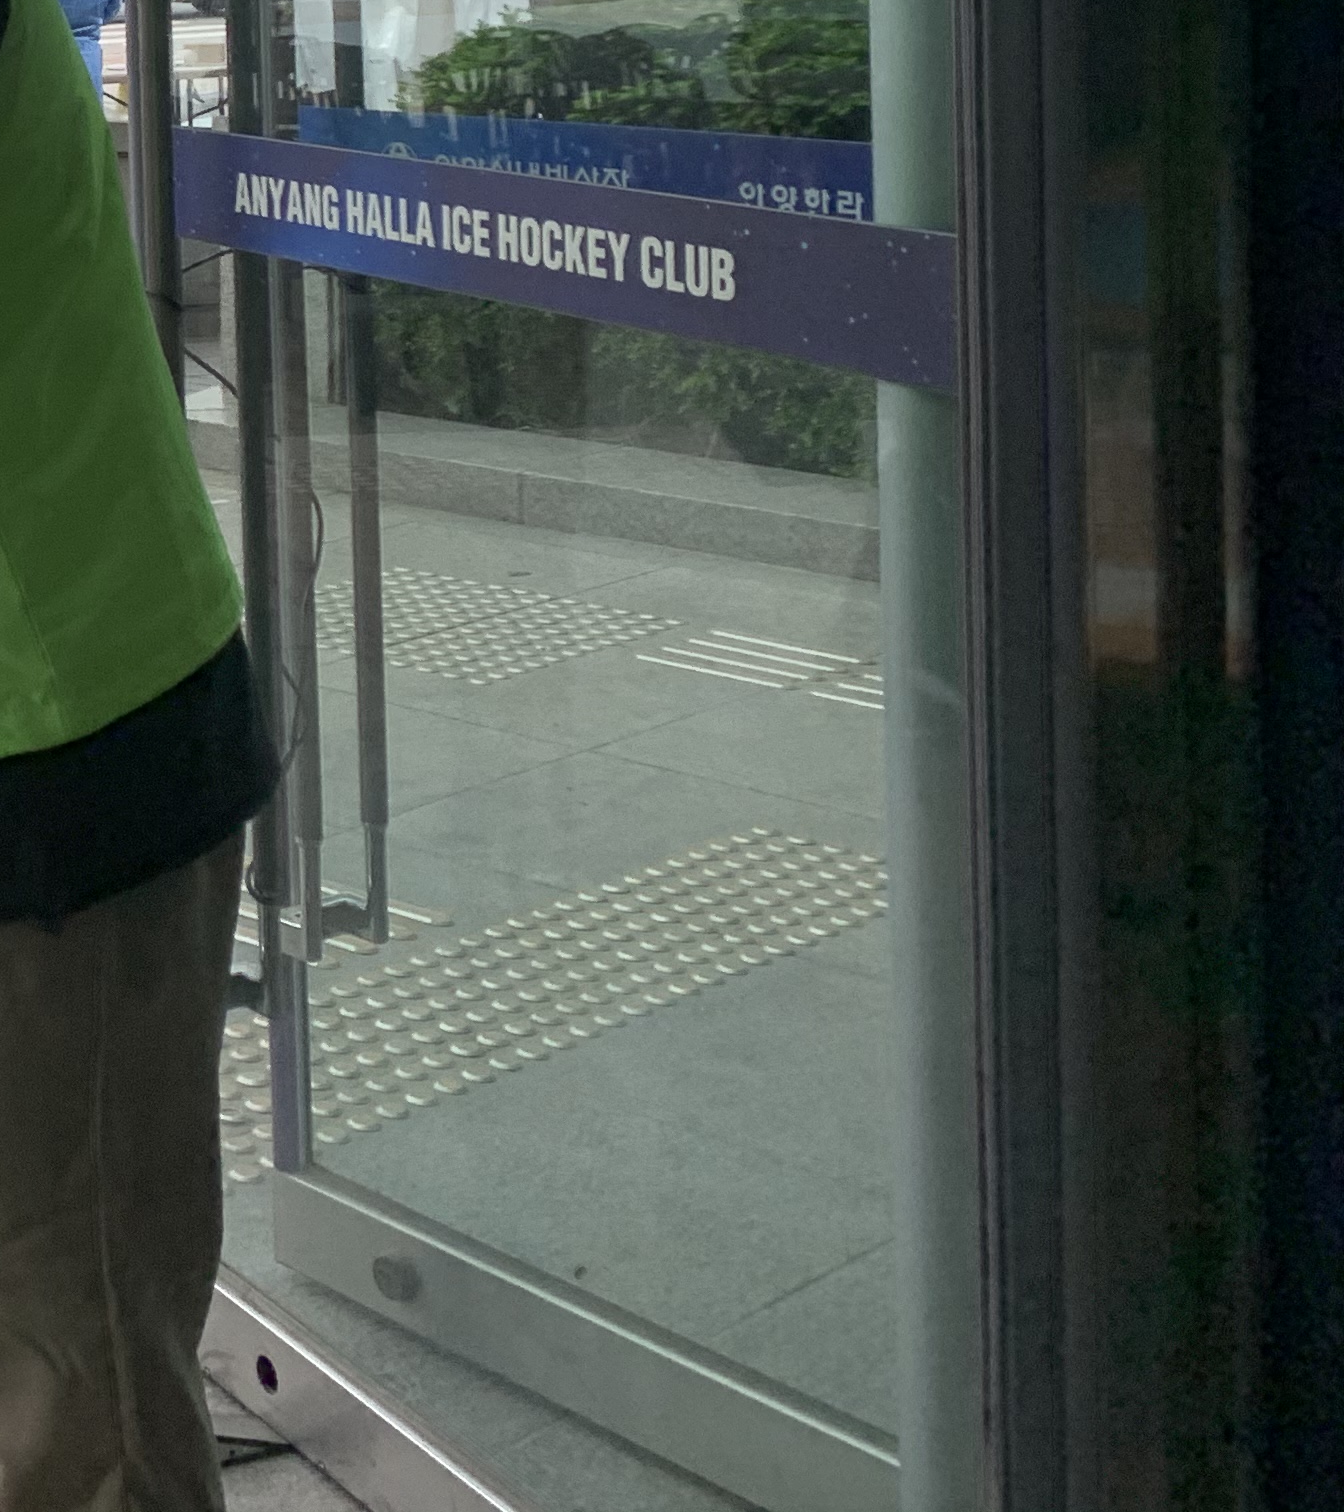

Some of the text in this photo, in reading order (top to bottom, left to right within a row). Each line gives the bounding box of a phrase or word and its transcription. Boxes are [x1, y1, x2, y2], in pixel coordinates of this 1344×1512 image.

[235, 172, 737, 301] ANYANG HALLA ICE HOCKEY CLUB
